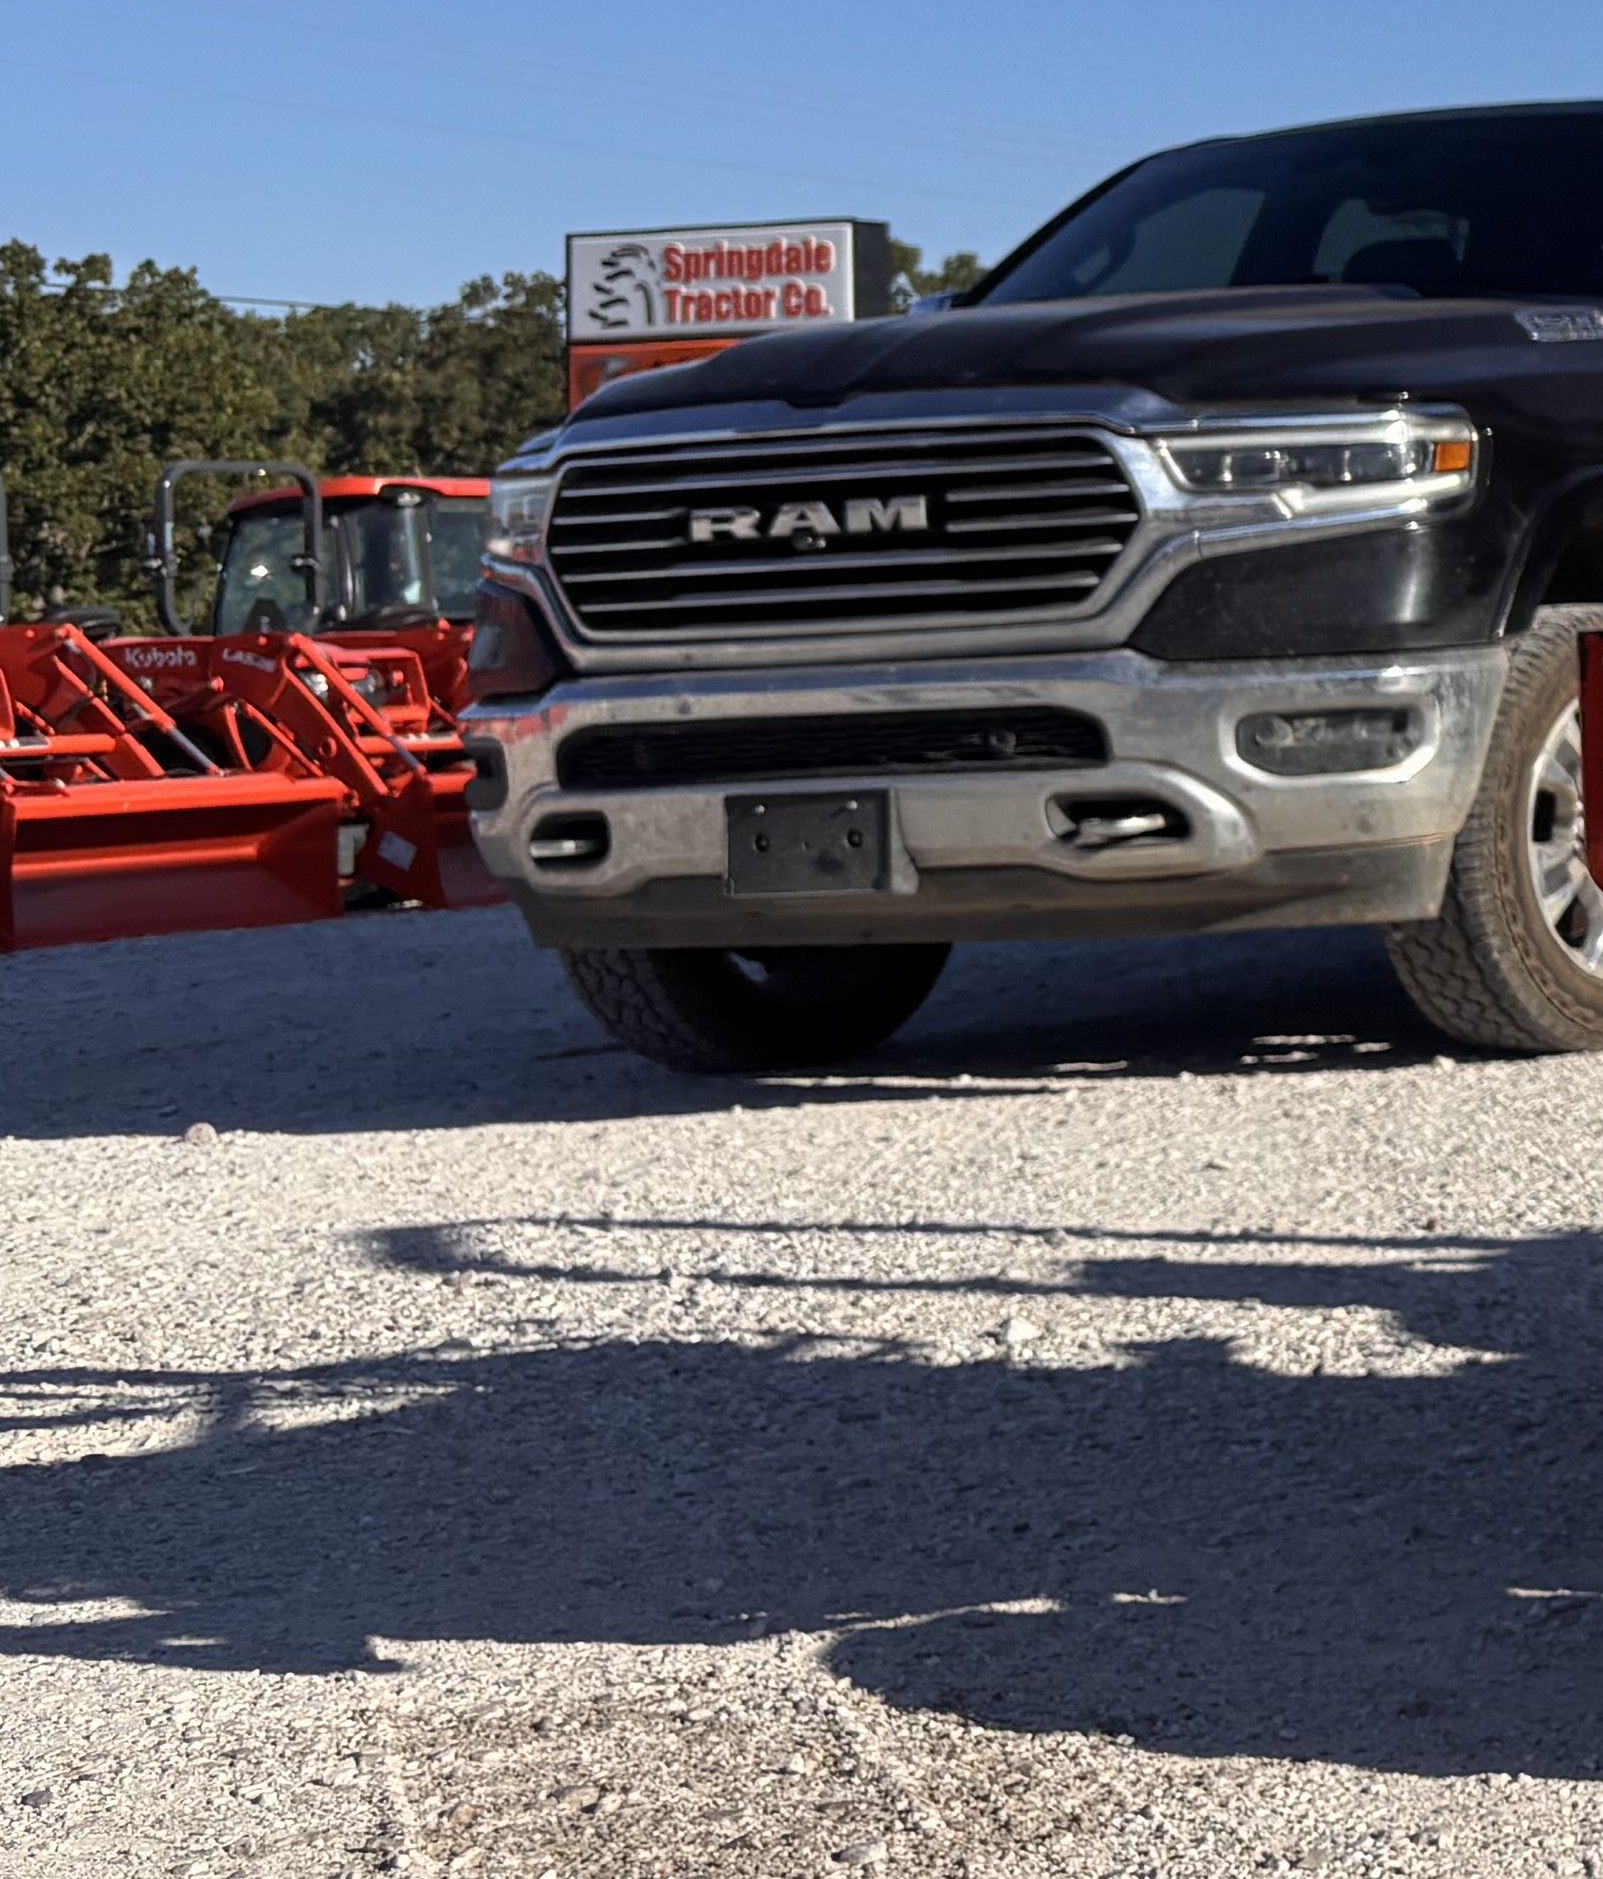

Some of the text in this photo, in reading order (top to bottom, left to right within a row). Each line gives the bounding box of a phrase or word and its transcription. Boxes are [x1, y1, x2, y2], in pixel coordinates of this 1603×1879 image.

[662, 236, 836, 283] Springdale
[663, 279, 833, 324] Tractor Co.
[690, 494, 928, 542] RAM
[124, 645, 198, 668] Kubota
